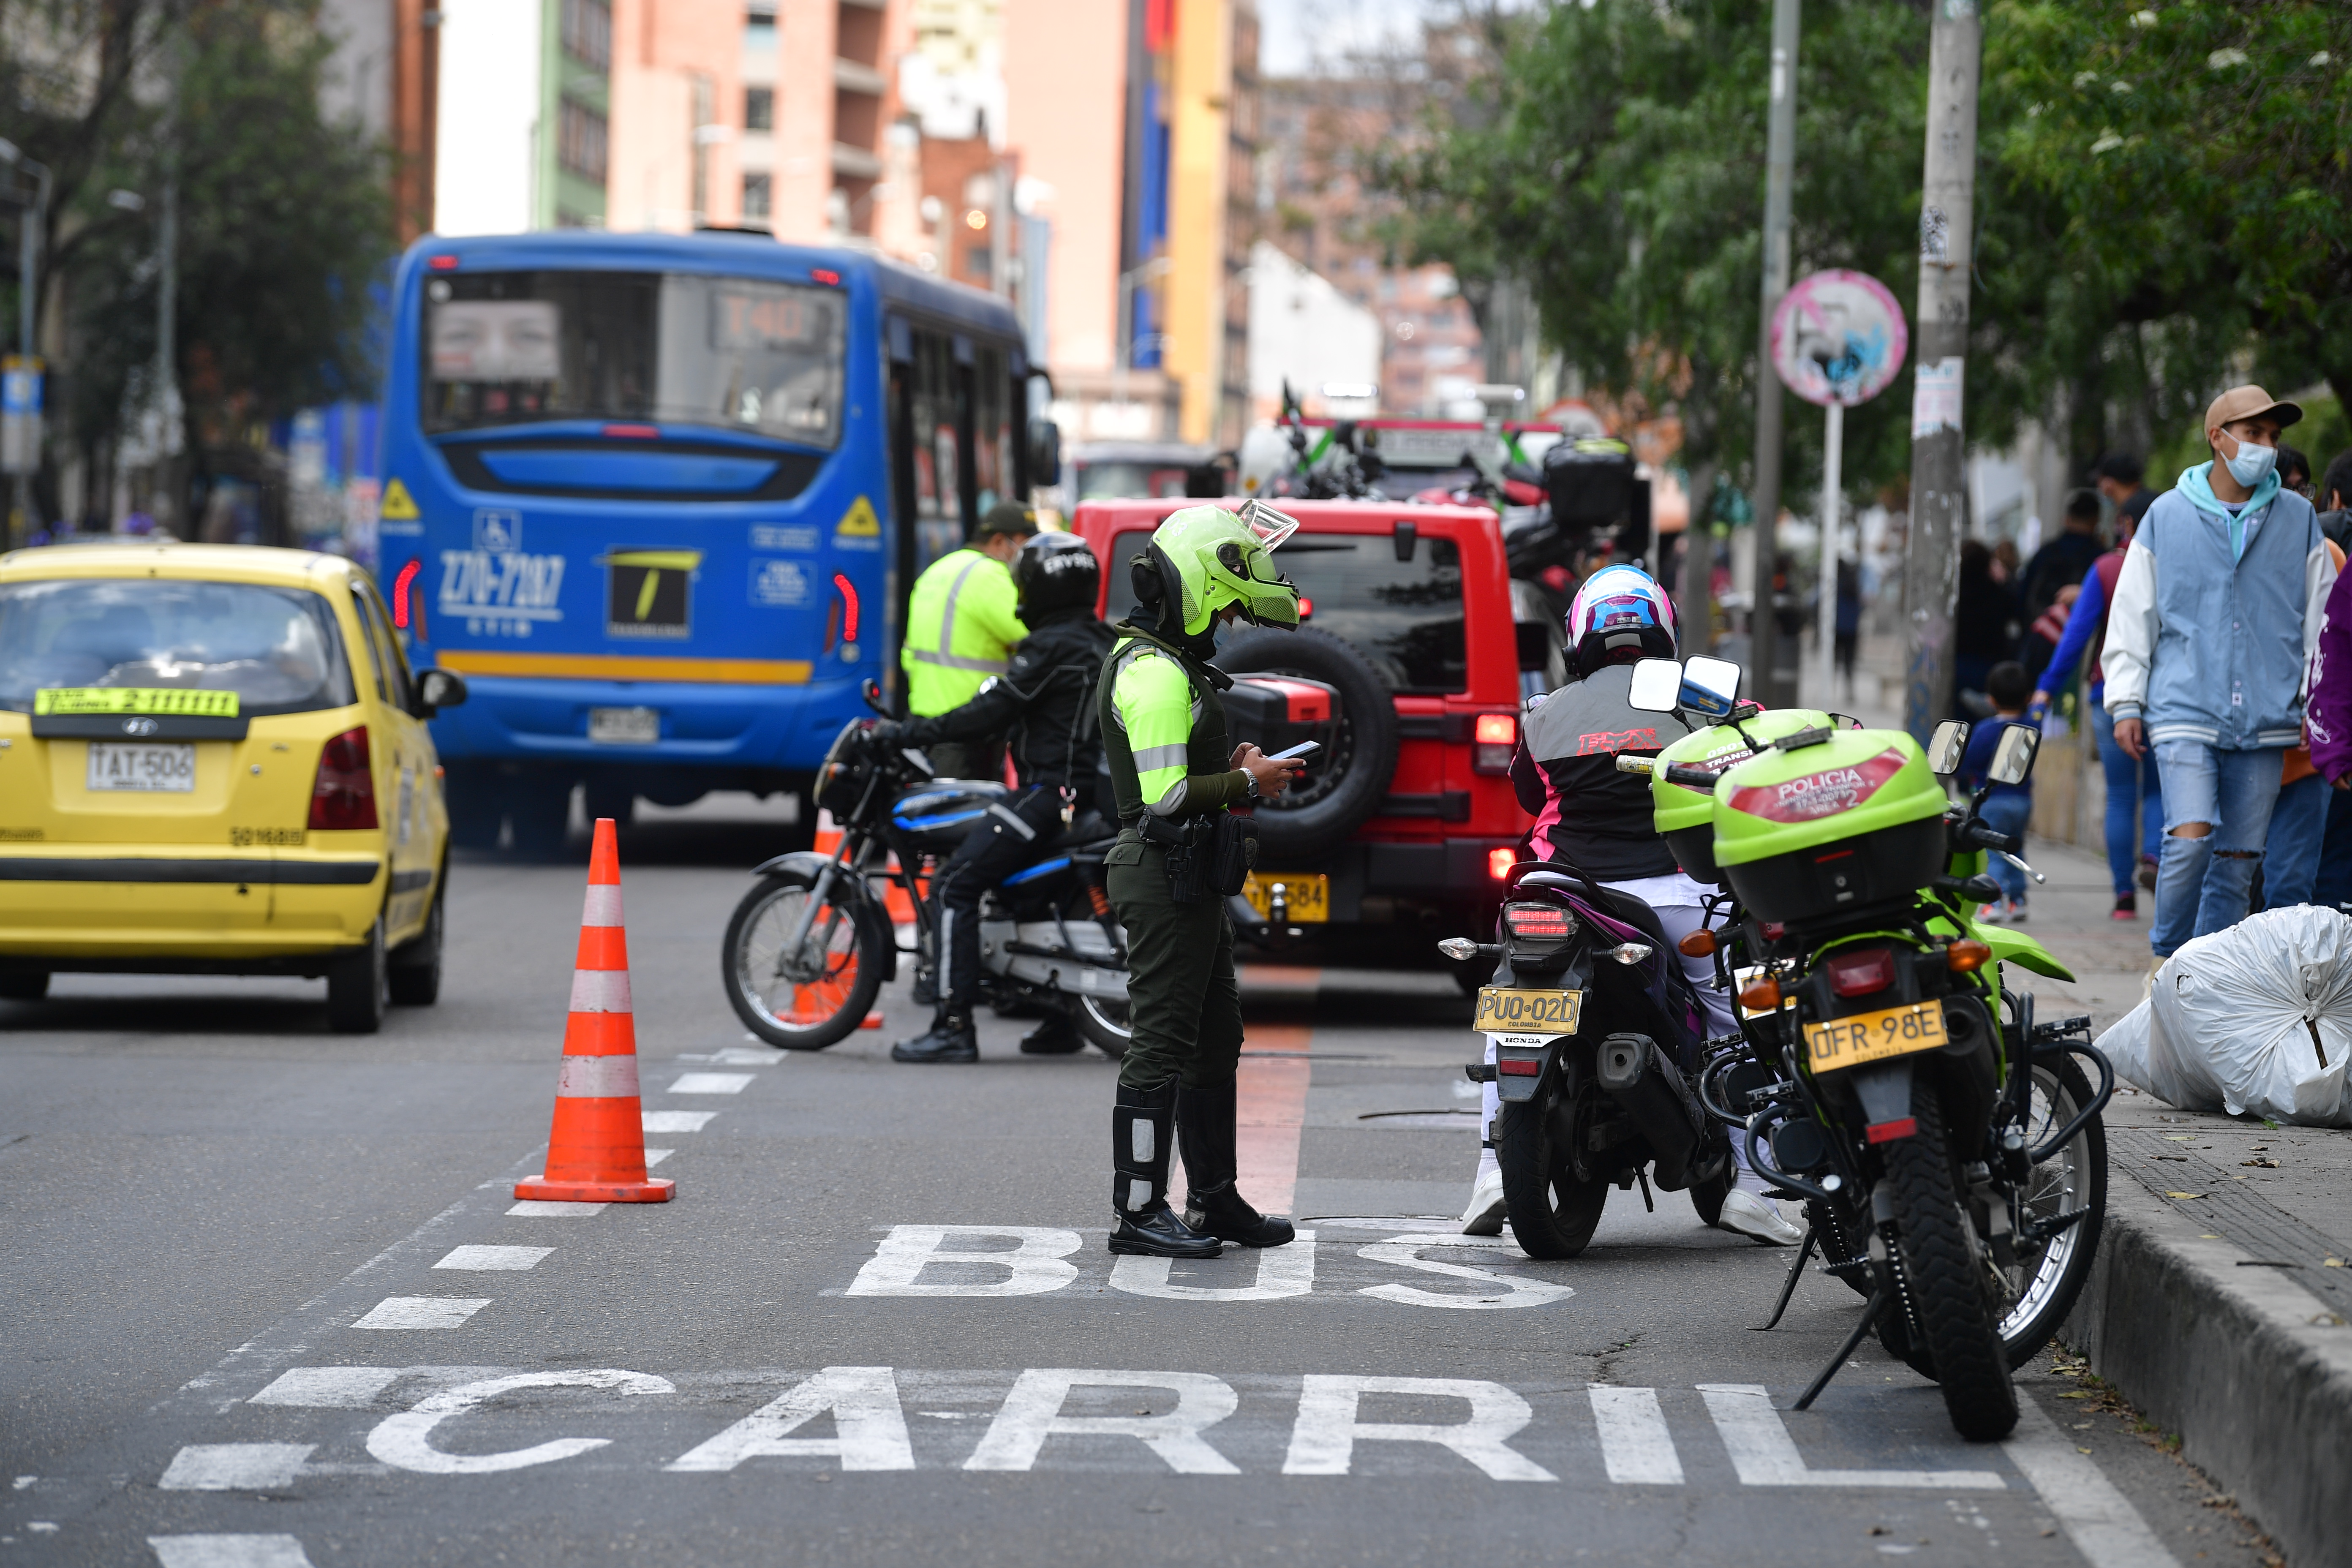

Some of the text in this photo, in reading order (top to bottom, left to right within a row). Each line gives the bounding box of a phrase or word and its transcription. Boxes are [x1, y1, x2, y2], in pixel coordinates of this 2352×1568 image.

[1706, 749, 1753, 768] TRANSI
[1707, 737, 1769, 759] 09016
[94, 749, 191, 778] TAT-506
[1778, 768, 1864, 800] POLICIA
[844, 1224, 1576, 1309] BUS
[366, 1366, 2005, 1488] CARRIL
